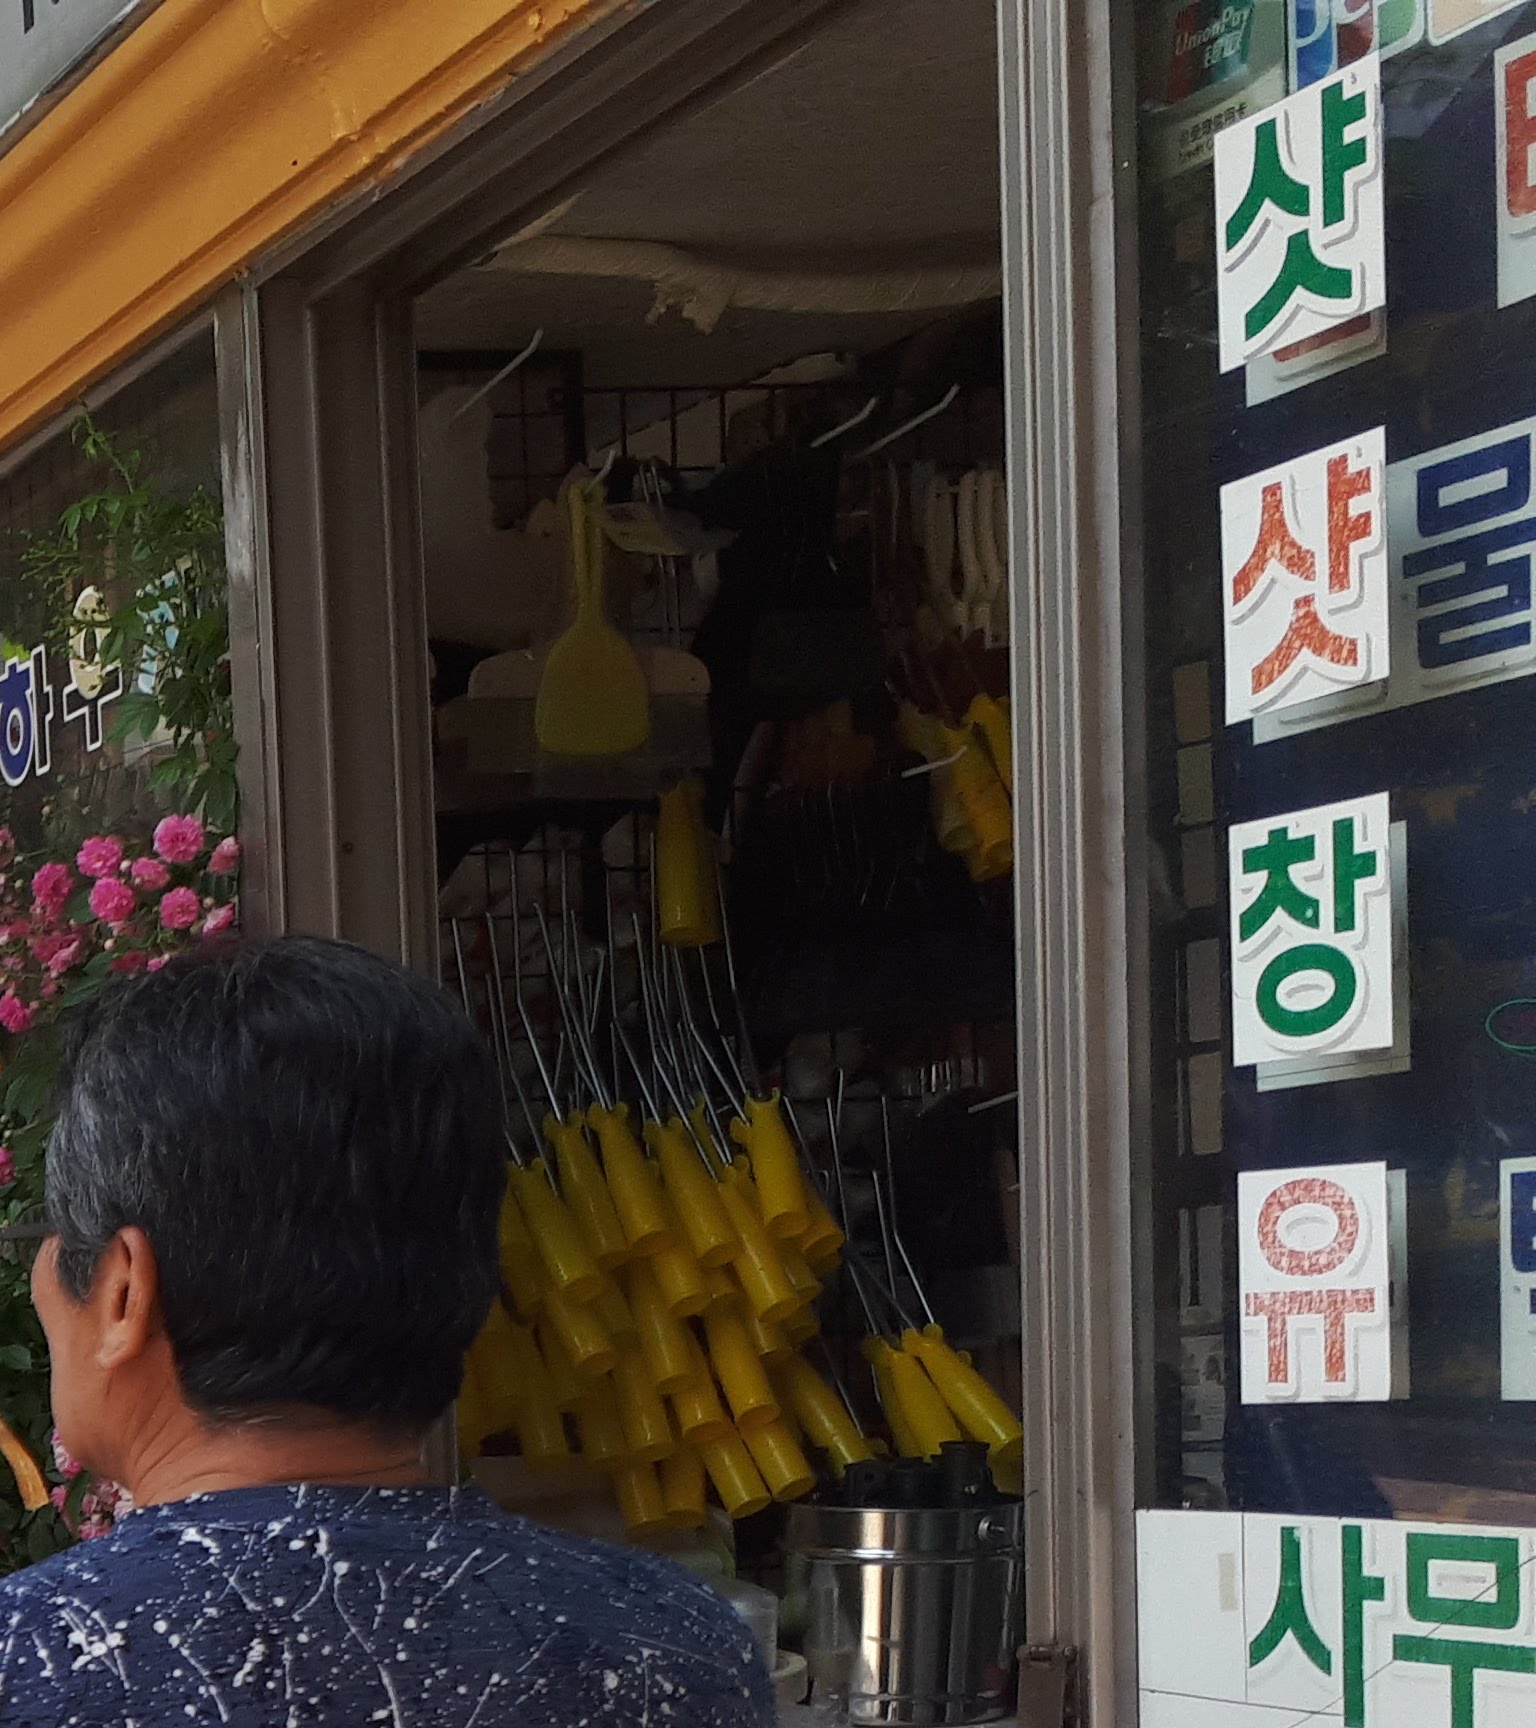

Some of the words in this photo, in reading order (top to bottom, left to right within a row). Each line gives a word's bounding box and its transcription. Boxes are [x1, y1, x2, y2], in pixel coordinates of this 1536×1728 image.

[1175, 5, 1251, 56] UnionPay
[1225, 80, 1367, 342] 샷
[1232, 452, 1373, 697] 샷
[1239, 816, 1379, 1037] 창
[1244, 1178, 1376, 1384] 유
